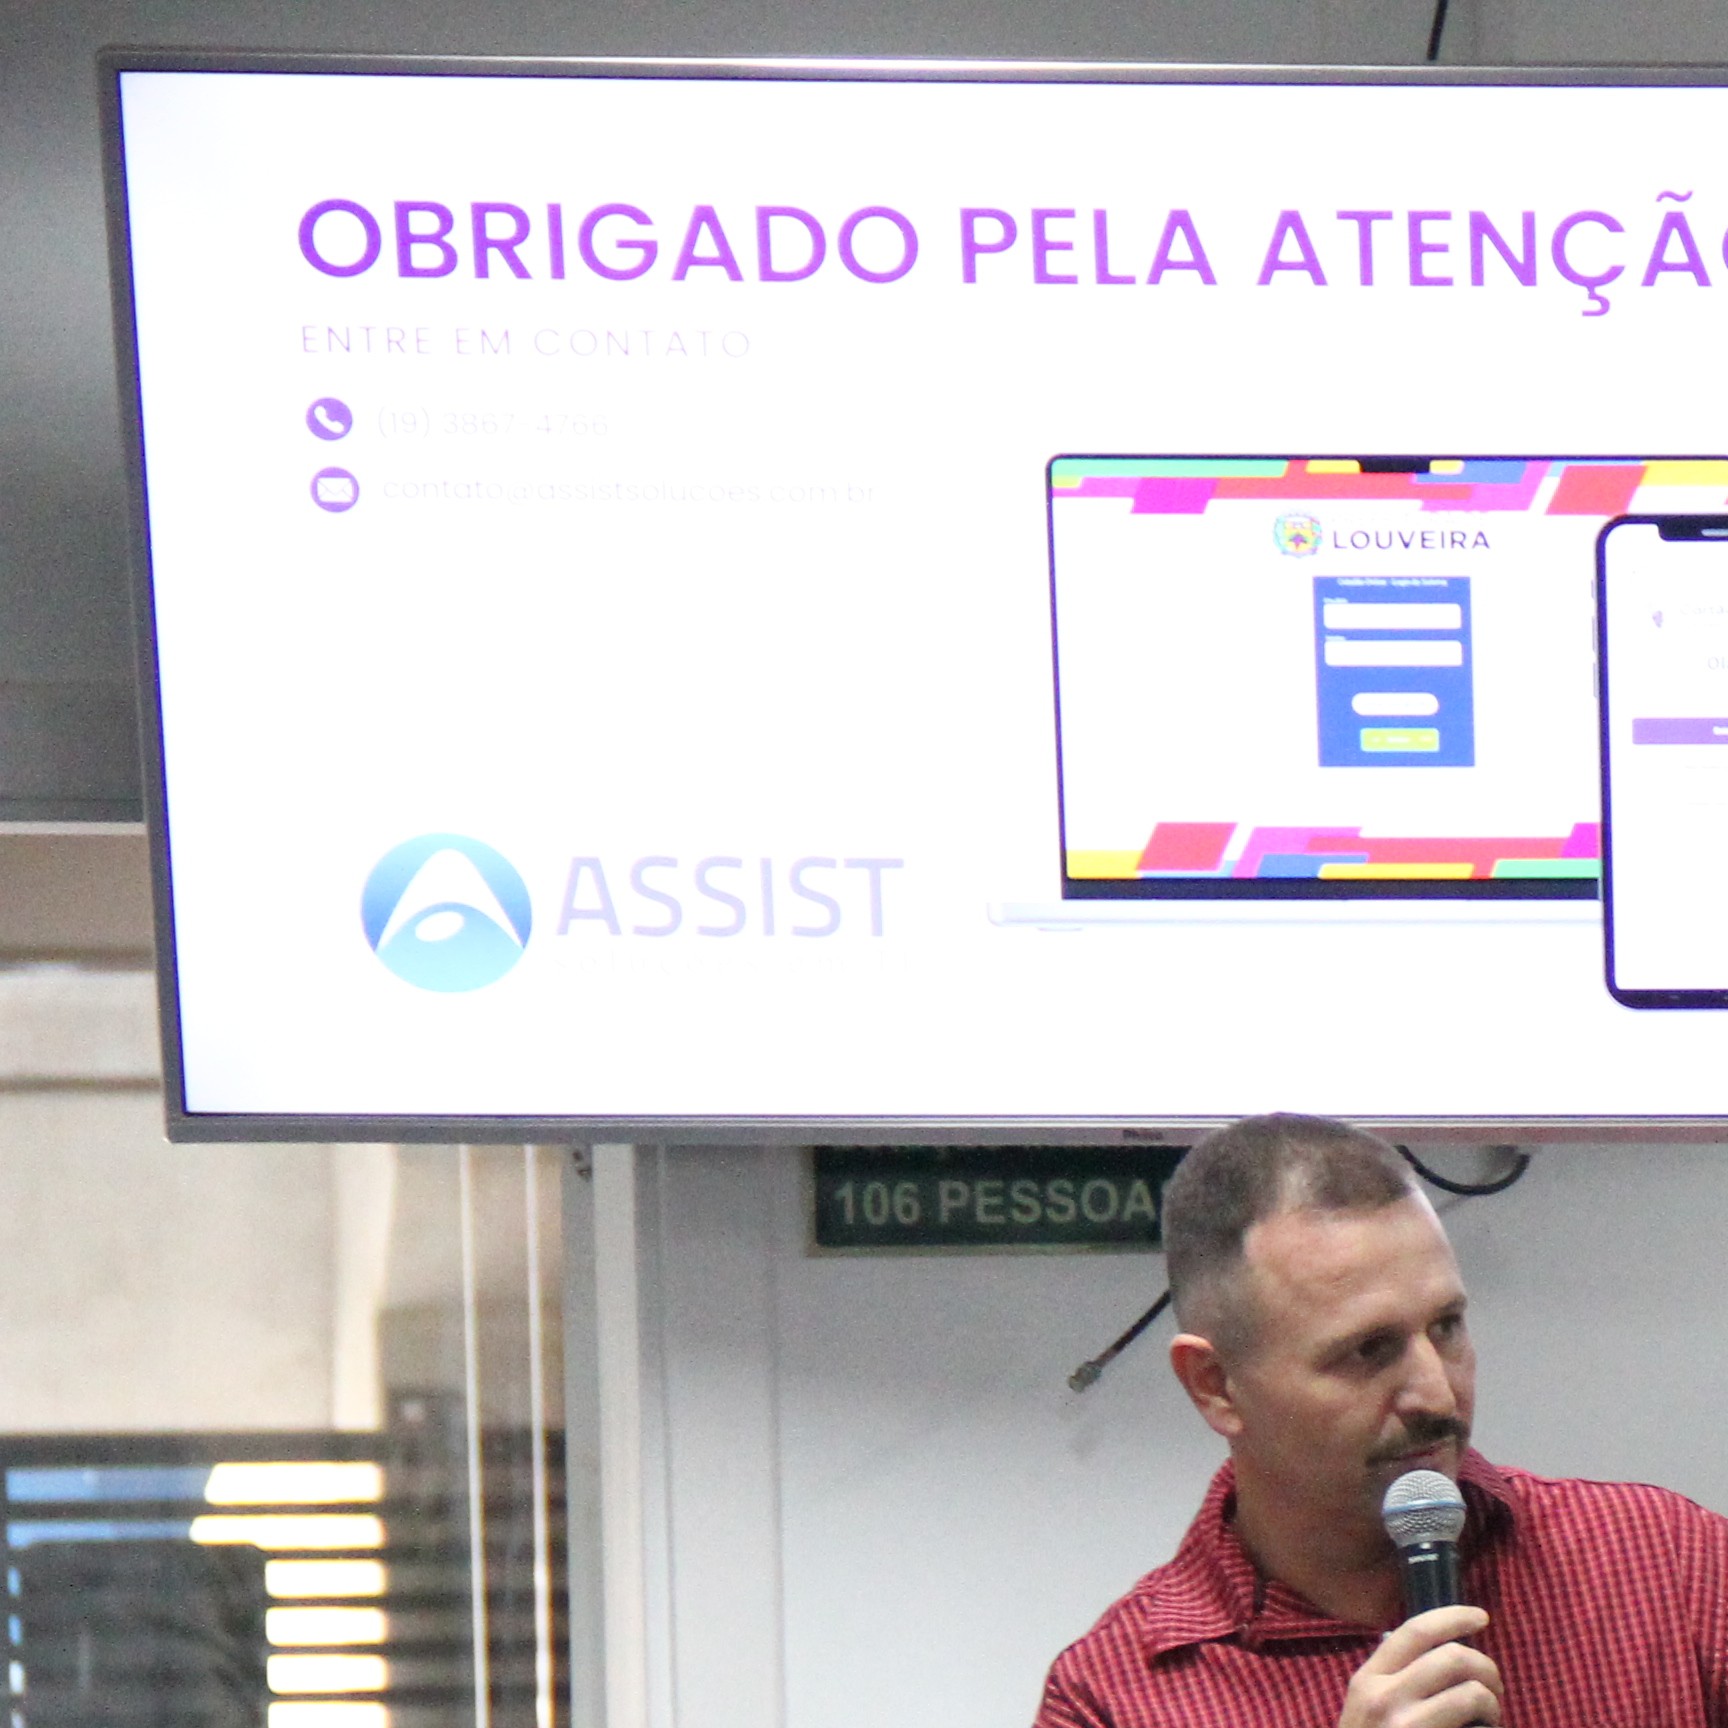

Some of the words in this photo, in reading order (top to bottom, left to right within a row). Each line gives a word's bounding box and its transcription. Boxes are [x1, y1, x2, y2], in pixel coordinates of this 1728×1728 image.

[297, 197, 920, 285] OBRIGADO
[959, 206, 1218, 286] PELA
[301, 324, 431, 354] ENTRE
[454, 326, 513, 356] EM
[532, 327, 752, 359] CONTATO
[377, 405, 431, 438] (19)
[1331, 529, 1492, 551] LOUVEIRA
[556, 855, 905, 938] ASSIST
[835, 1180, 921, 1226] 106
[938, 1178, 1168, 1225] PESSOA
